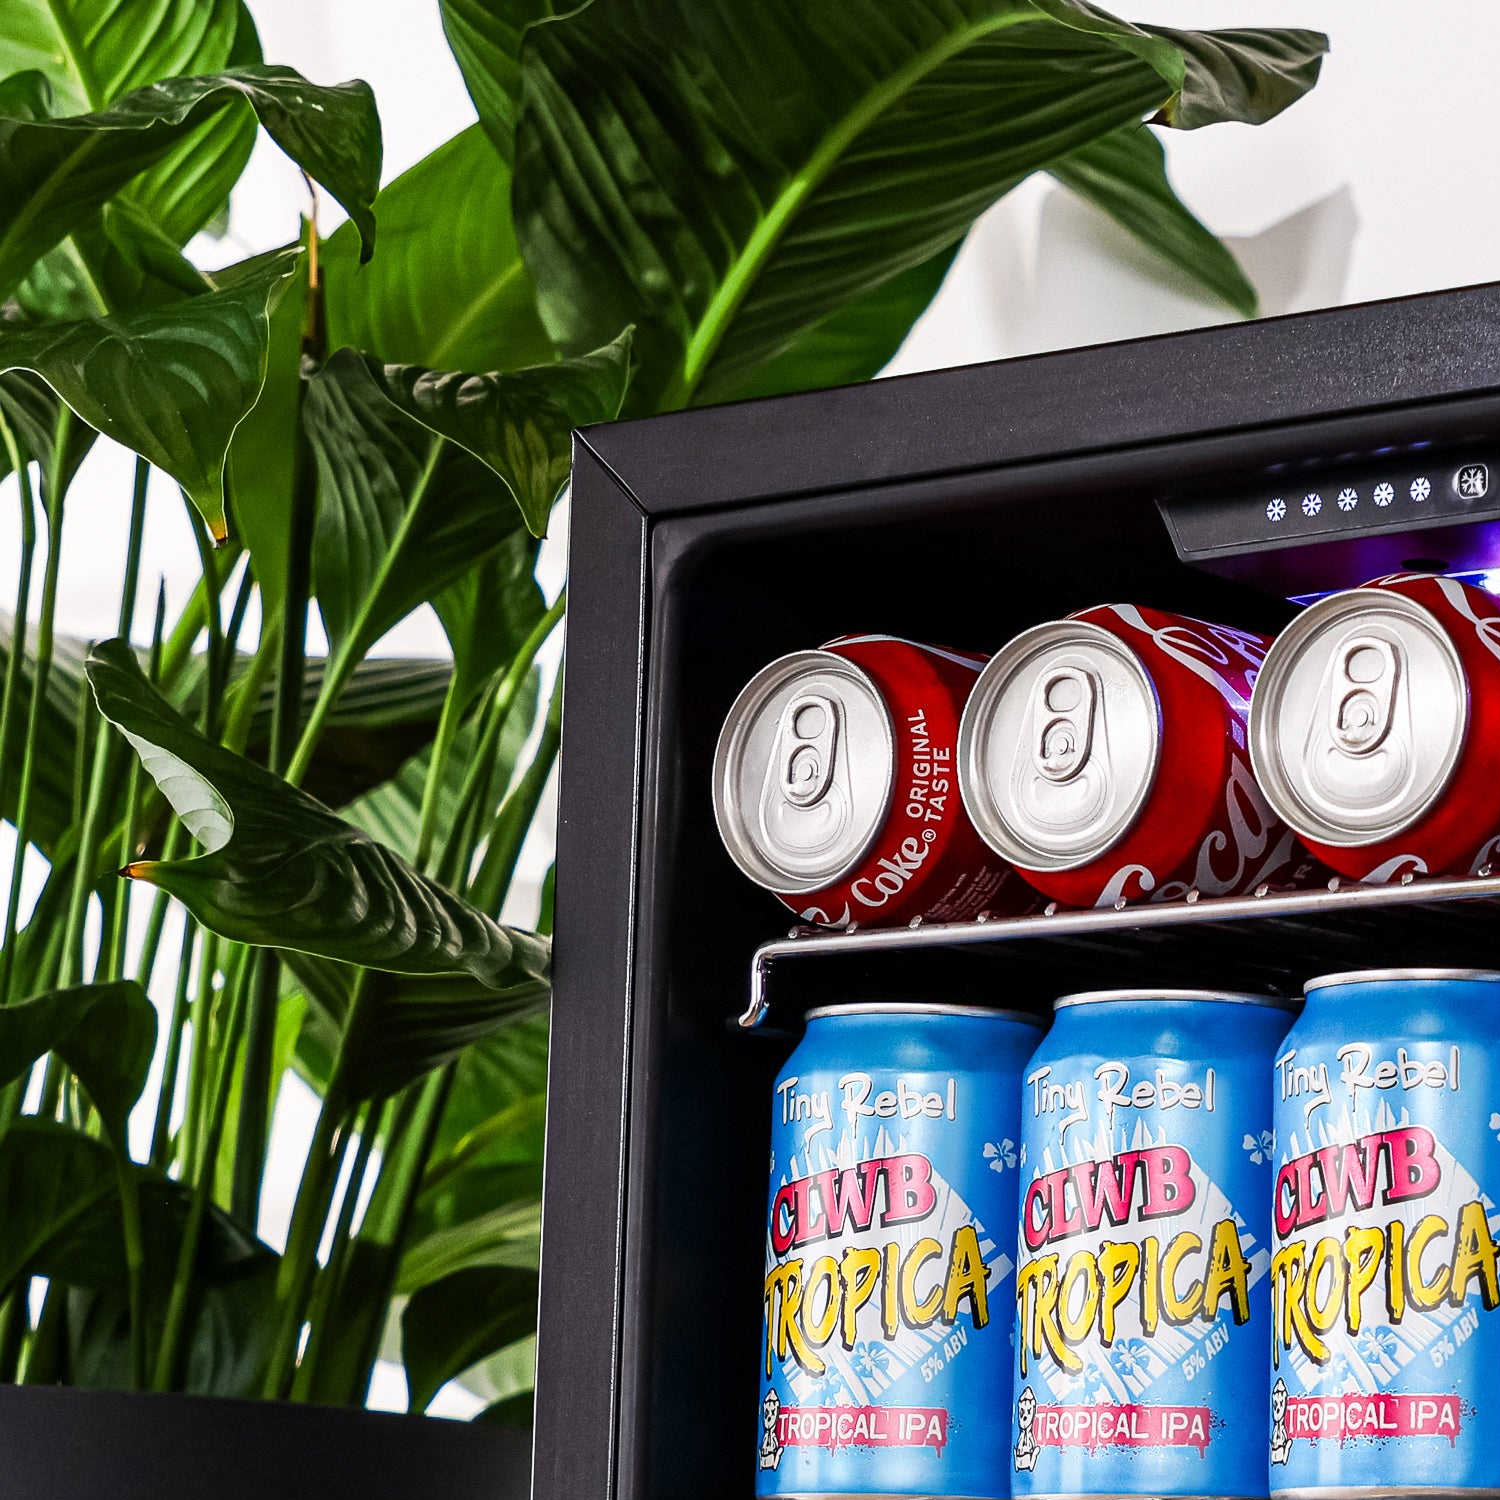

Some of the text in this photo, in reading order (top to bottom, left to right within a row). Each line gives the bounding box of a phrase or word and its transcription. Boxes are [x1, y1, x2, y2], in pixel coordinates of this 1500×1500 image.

[906, 708, 931, 819] ORIGINAL
[924, 747, 950, 822] TASTE
[777, 1072, 957, 1152] Tiny Rebel
[1027, 1061, 1216, 1145] Tiny Rebel
[1274, 1042, 1460, 1130] Tiny Rebel
[770, 1152, 938, 1255] CLWB
[1023, 1144, 1198, 1251] CLWB
[1274, 1126, 1441, 1241] CLWB
[764, 1223, 991, 1380] TROPICA
[1017, 1219, 1251, 1380] TROPICA
[1429, 1307, 1479, 1368] 5% ABV
[920, 1325, 968, 1383] 5% ABV
[1181, 1322, 1229, 1381] 5% ABV
[779, 1412, 943, 1443] TROPICAL IPA
[1036, 1412, 1206, 1443] TROPICAL IPA
[1287, 1402, 1456, 1431] TROPICAL IPA
